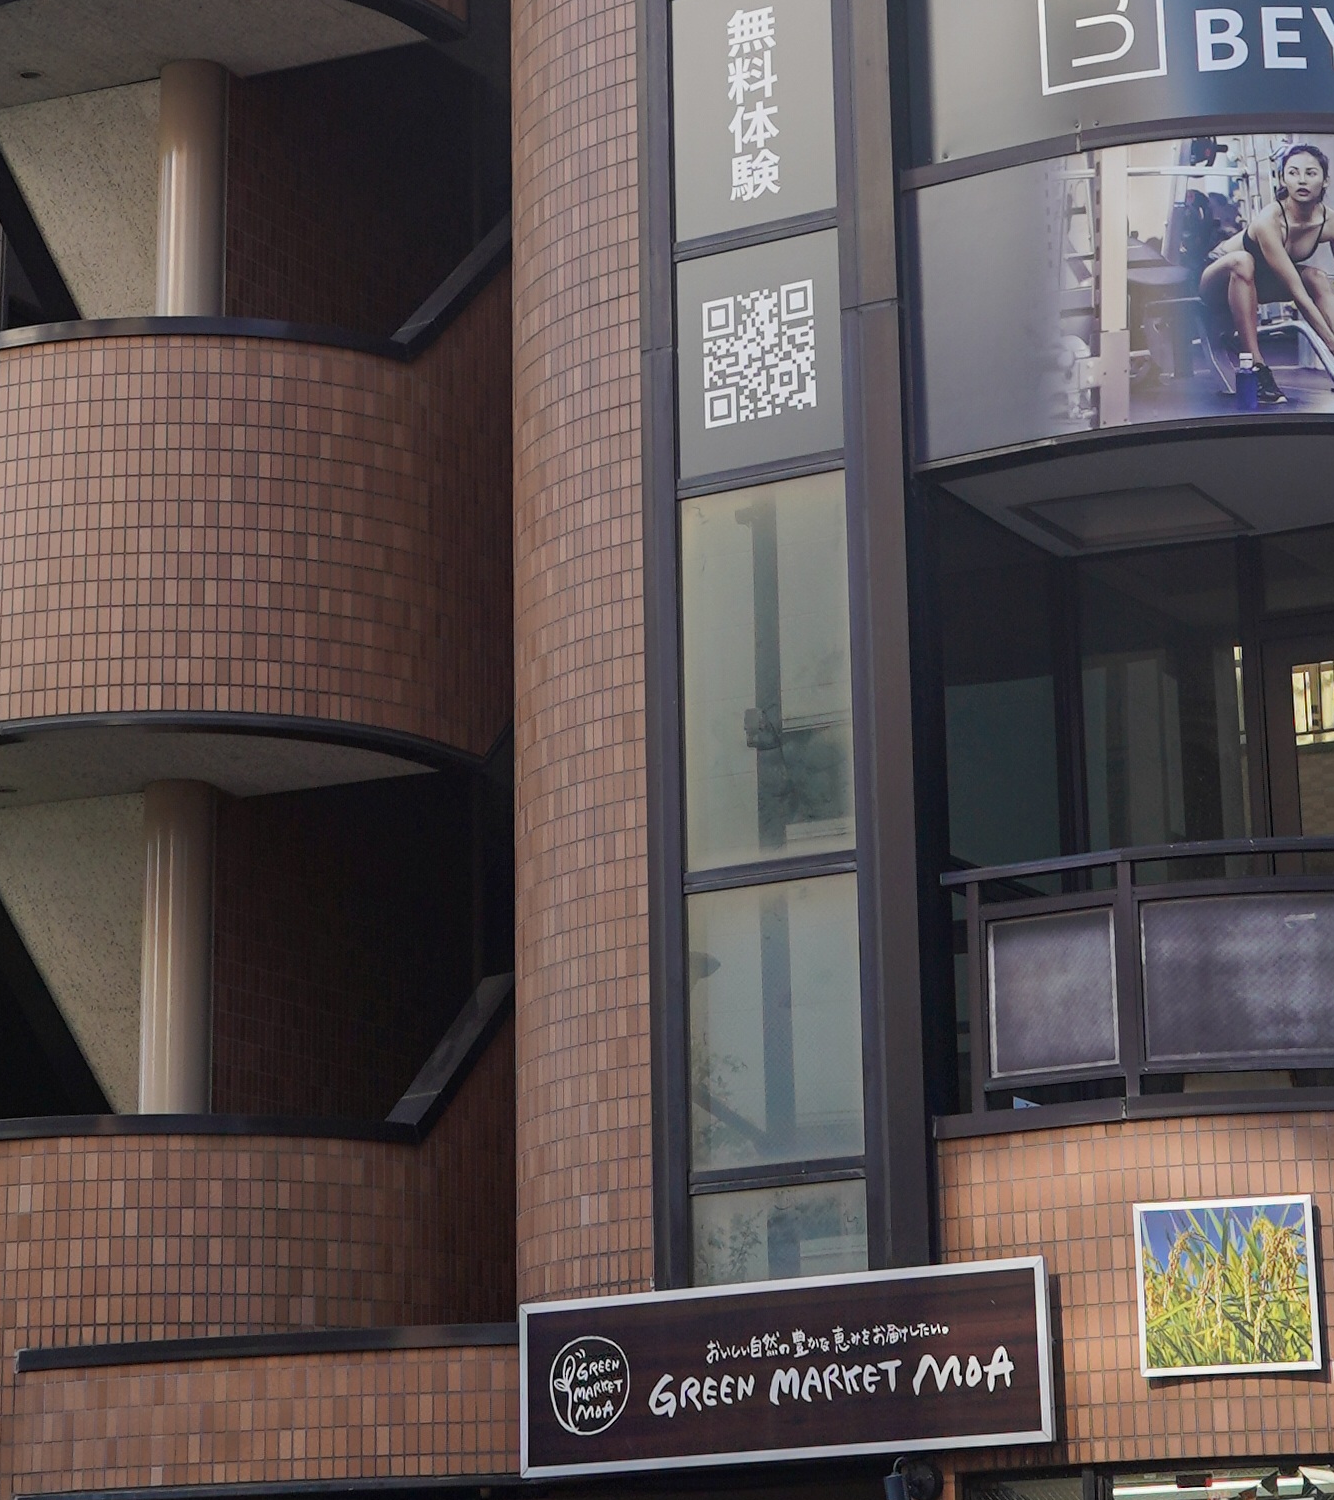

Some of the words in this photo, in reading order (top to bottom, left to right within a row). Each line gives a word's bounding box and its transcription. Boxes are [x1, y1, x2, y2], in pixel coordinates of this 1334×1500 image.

[727, 5, 781, 203] 無料体験
[576, 1358, 621, 1383] GREEN
[647, 1372, 755, 1418] GREEN
[769, 1358, 903, 1406] MARKET
[912, 1344, 1015, 1397] MOA
[573, 1377, 624, 1404] MARKET
[575, 1399, 614, 1421] MOA
